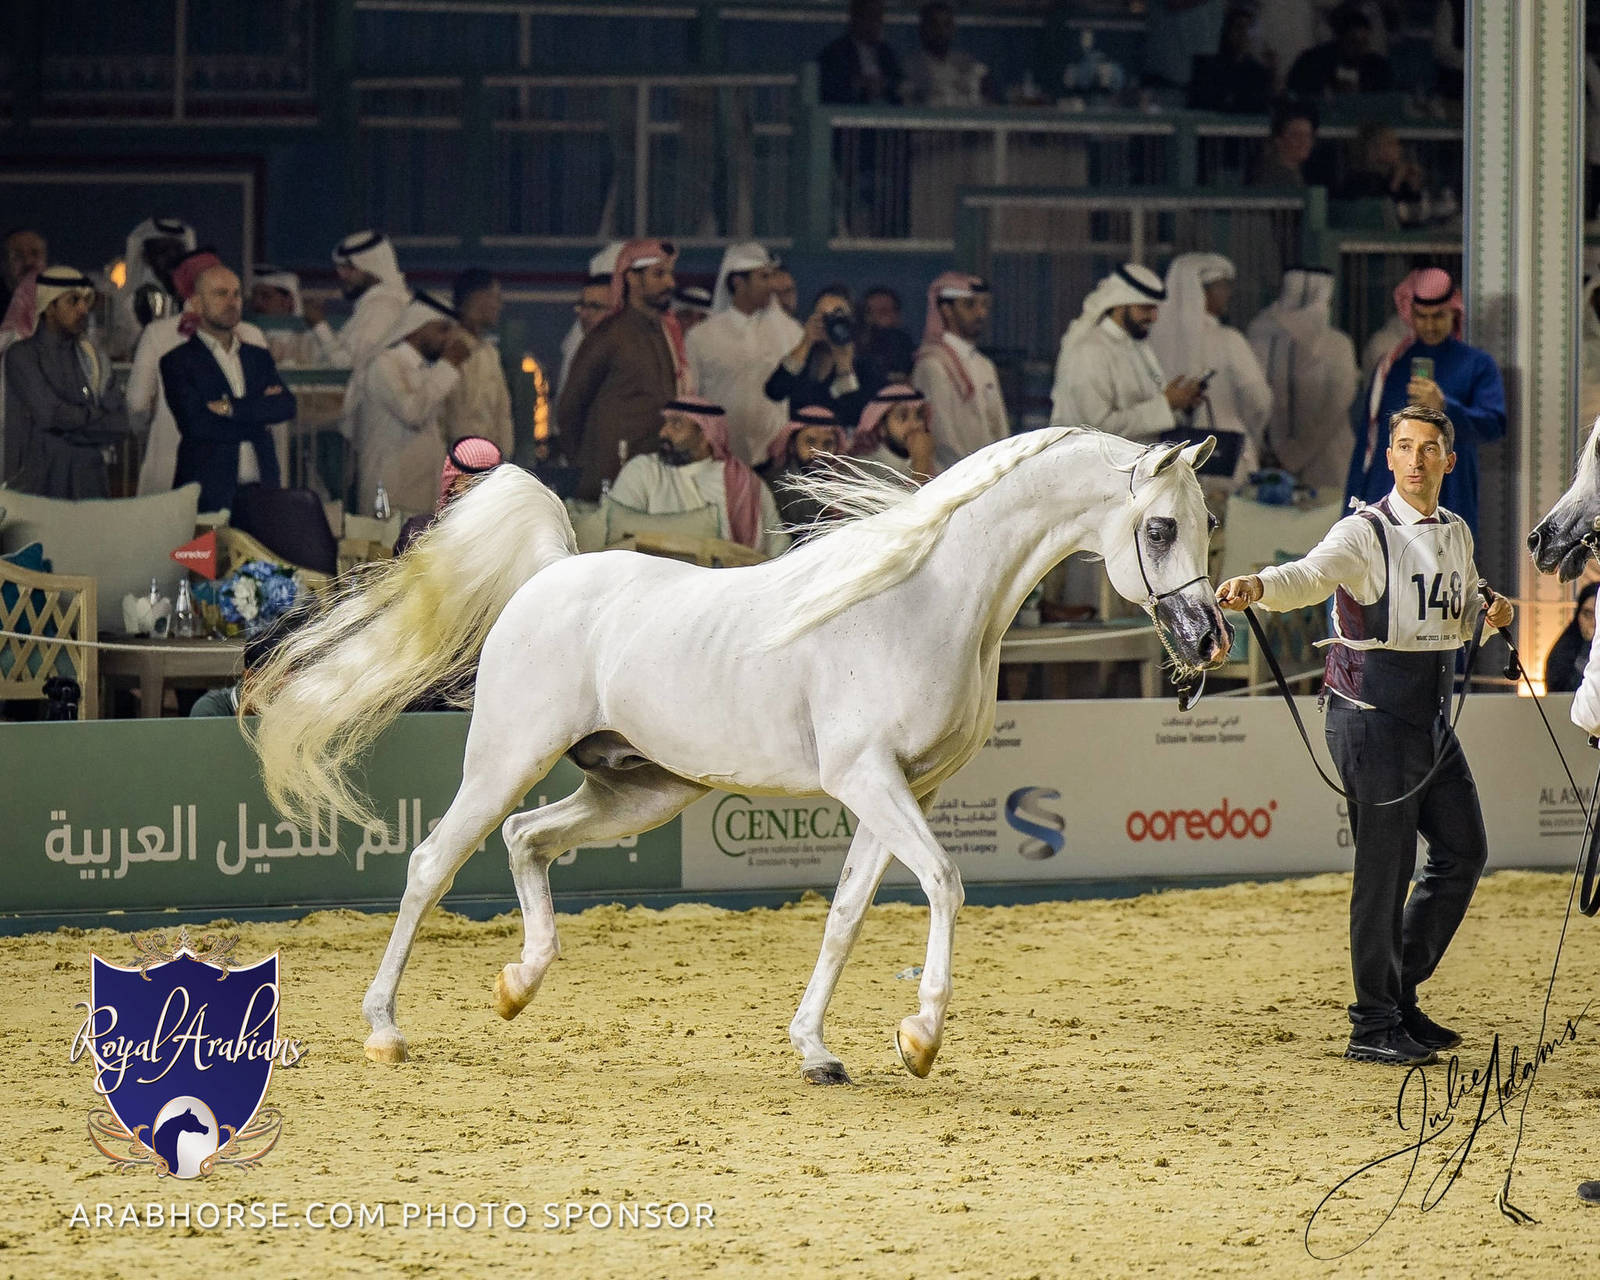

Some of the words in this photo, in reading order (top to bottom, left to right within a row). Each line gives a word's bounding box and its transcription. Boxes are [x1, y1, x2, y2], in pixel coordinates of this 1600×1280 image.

[1411, 571, 1463, 621] 148
[45, 804, 197, 879] العربية
[725, 805, 853, 841] CENECA
[1126, 798, 1273, 842] ooredoo
